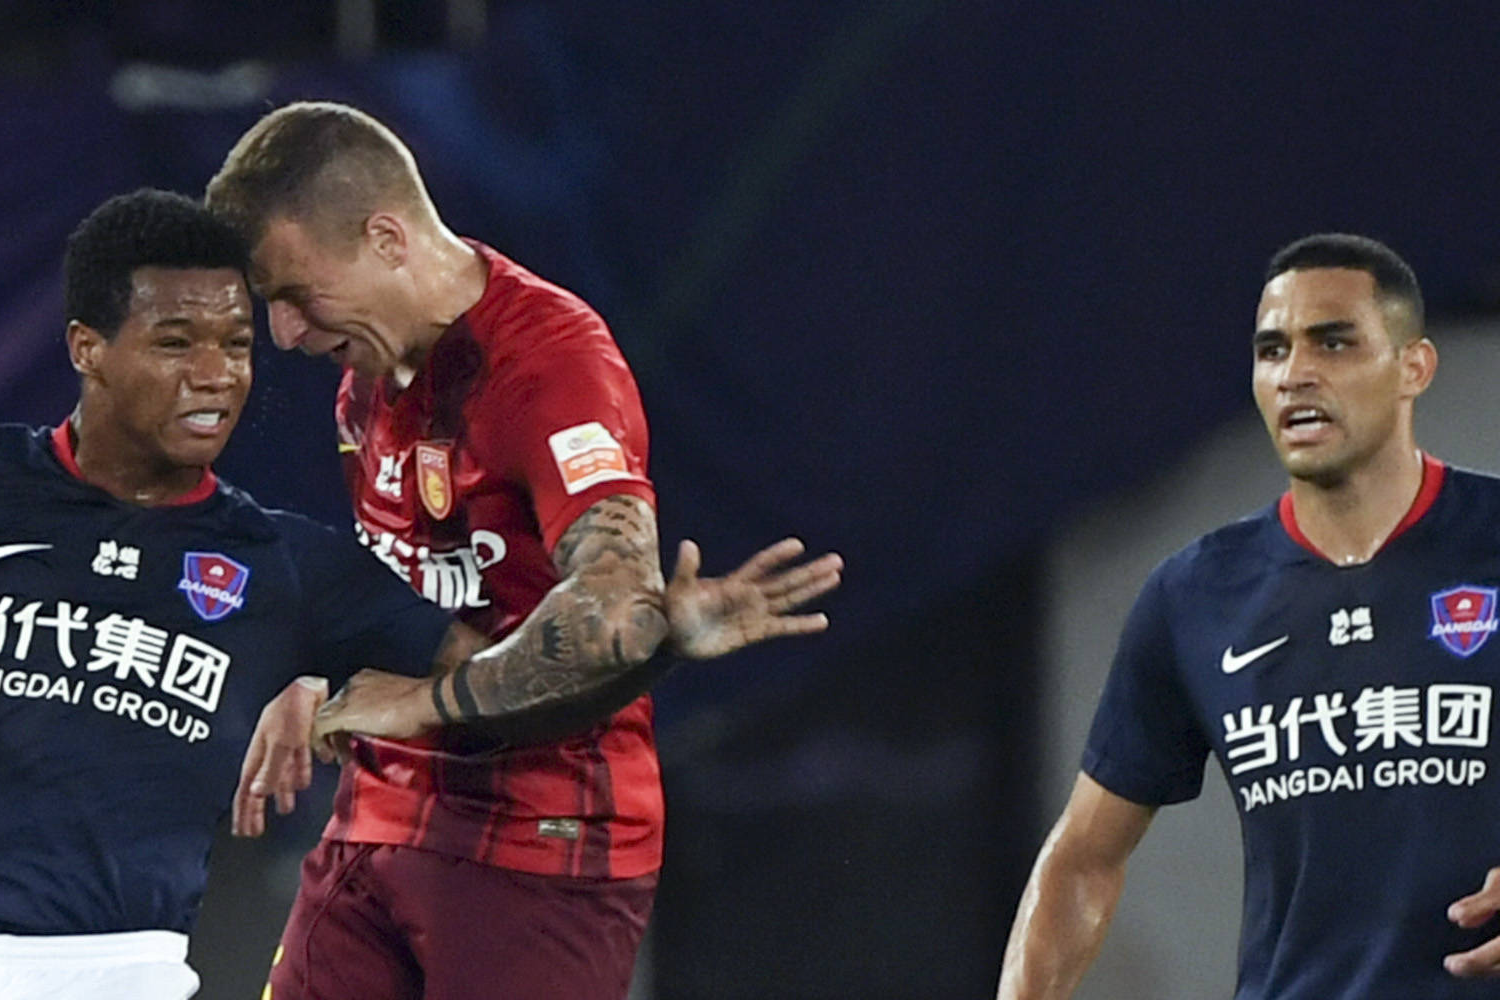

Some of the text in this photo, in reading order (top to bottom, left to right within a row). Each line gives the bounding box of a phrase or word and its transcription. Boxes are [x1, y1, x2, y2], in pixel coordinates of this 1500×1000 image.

[93, 685, 211, 743] GROUP
[1223, 684, 1492, 775] 当代集团
[1373, 757, 1486, 787] GROUP
